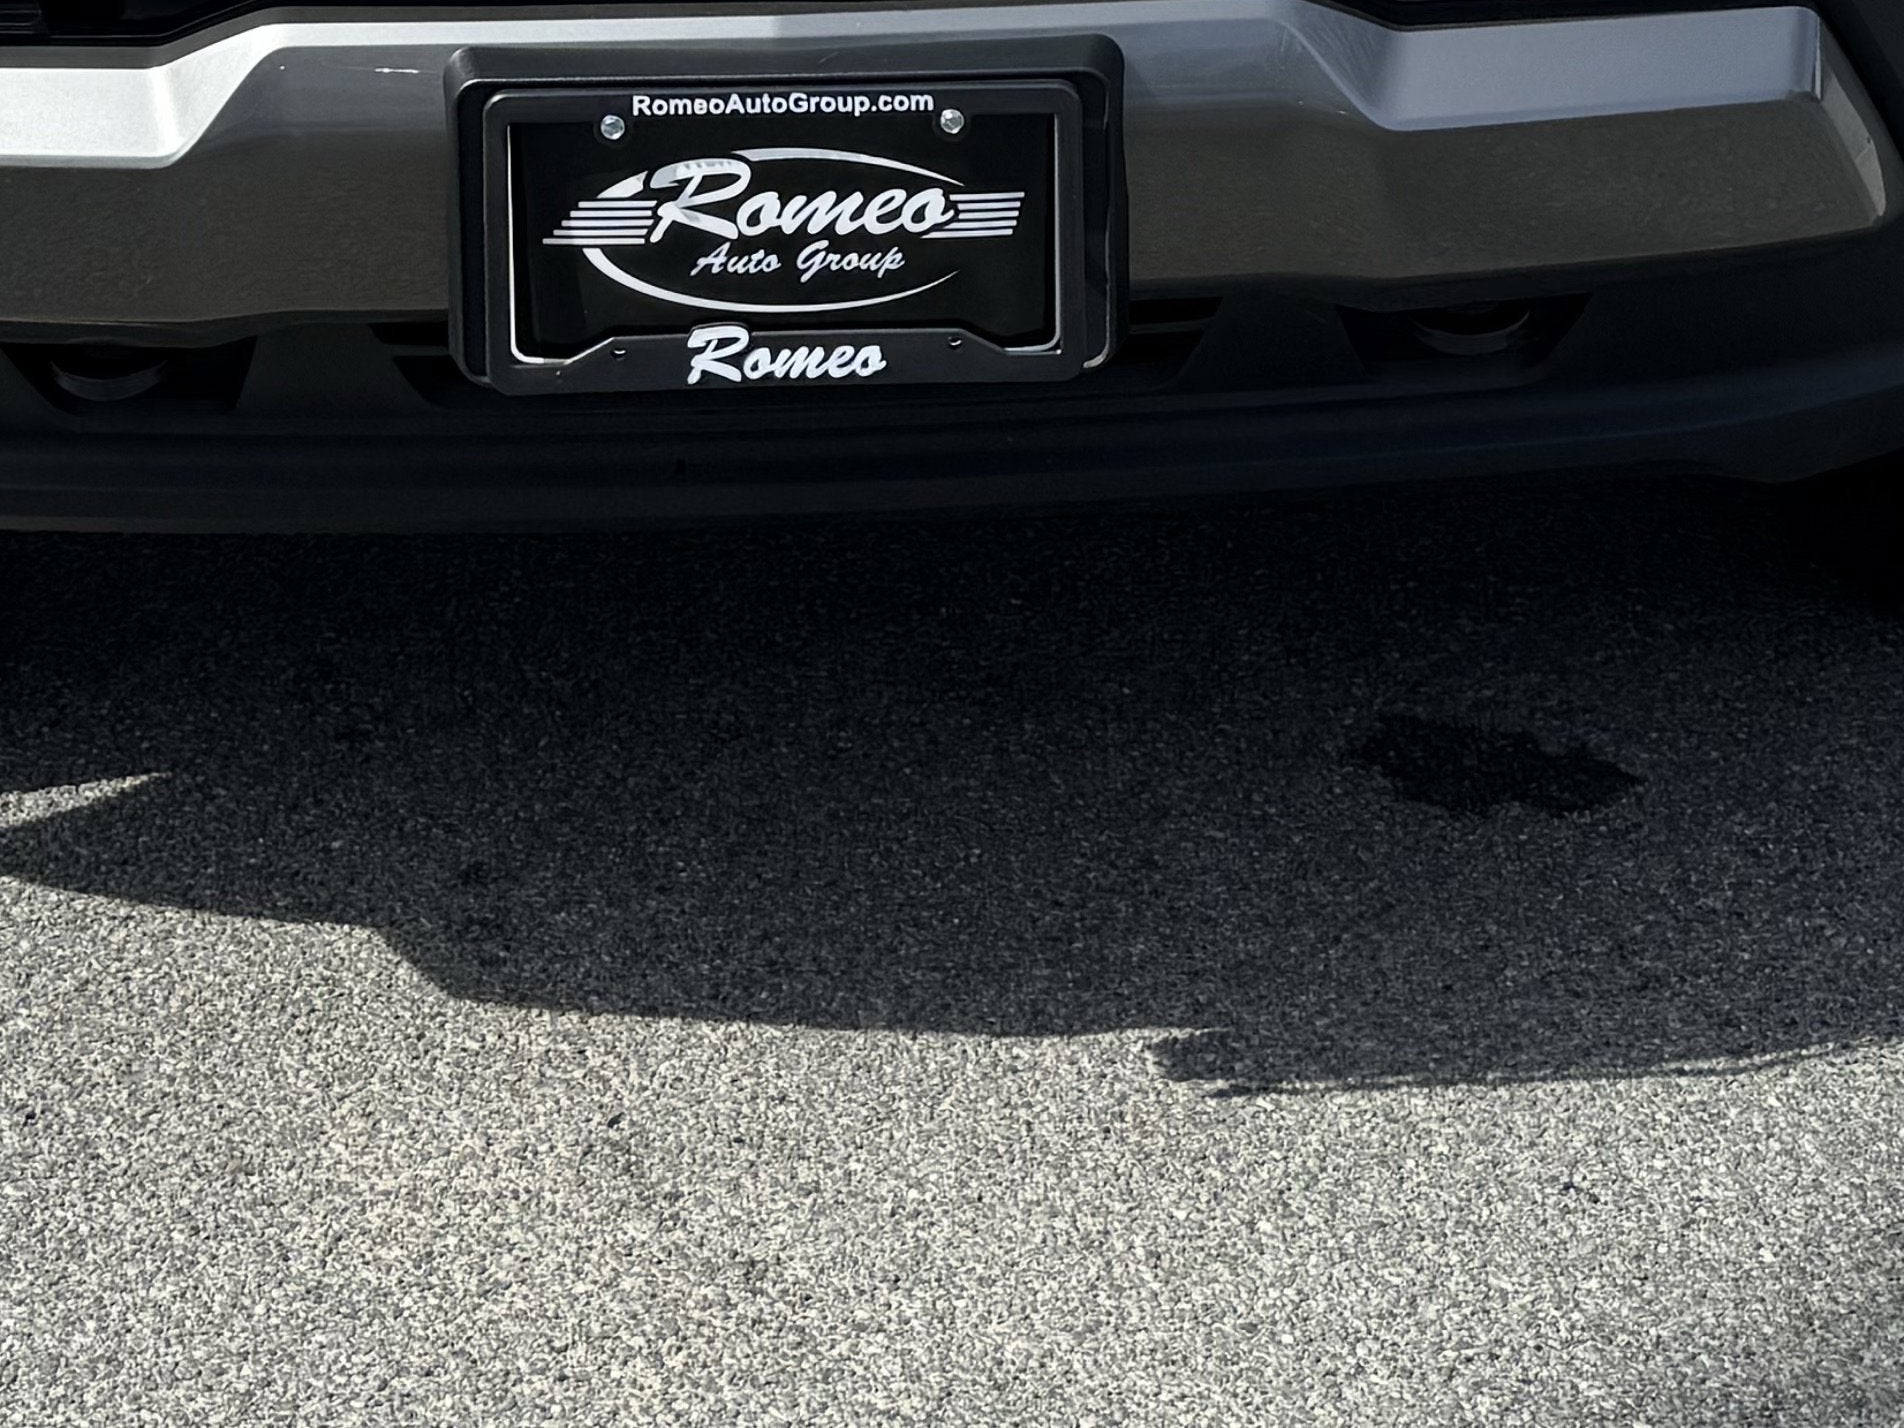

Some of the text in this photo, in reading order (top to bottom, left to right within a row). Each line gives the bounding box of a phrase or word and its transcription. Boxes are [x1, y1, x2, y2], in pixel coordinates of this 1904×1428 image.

[632, 92, 934, 117] RomeoAutoGroup.com
[651, 159, 955, 243] Romeo
[691, 241, 905, 282] Auto Group
[688, 325, 887, 385] Romeo
